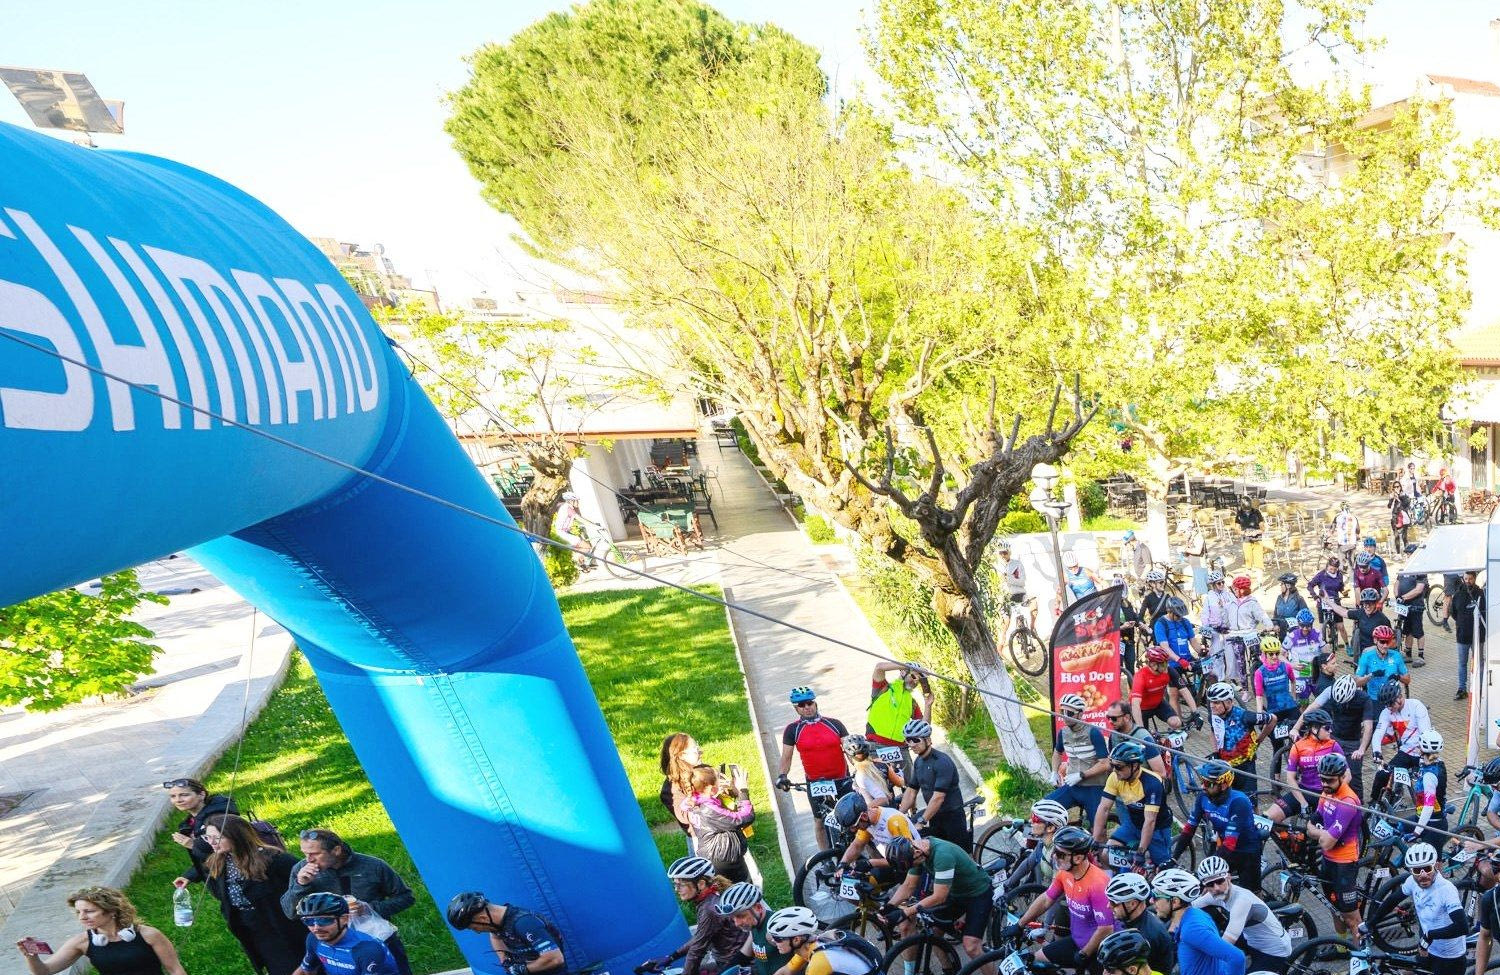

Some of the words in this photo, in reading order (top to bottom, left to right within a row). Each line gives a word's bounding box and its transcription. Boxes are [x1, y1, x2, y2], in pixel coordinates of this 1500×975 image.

[0, 208, 378, 431] SHIMANO
[1061, 672, 1085, 683] Hot
[1089, 671, 1114, 682] Dog
[1174, 736, 1184, 746] 61
[881, 750, 900, 761] 263
[813, 785, 835, 795] 264
[1113, 857, 1126, 866] 50
[842, 885, 853, 896] 55
